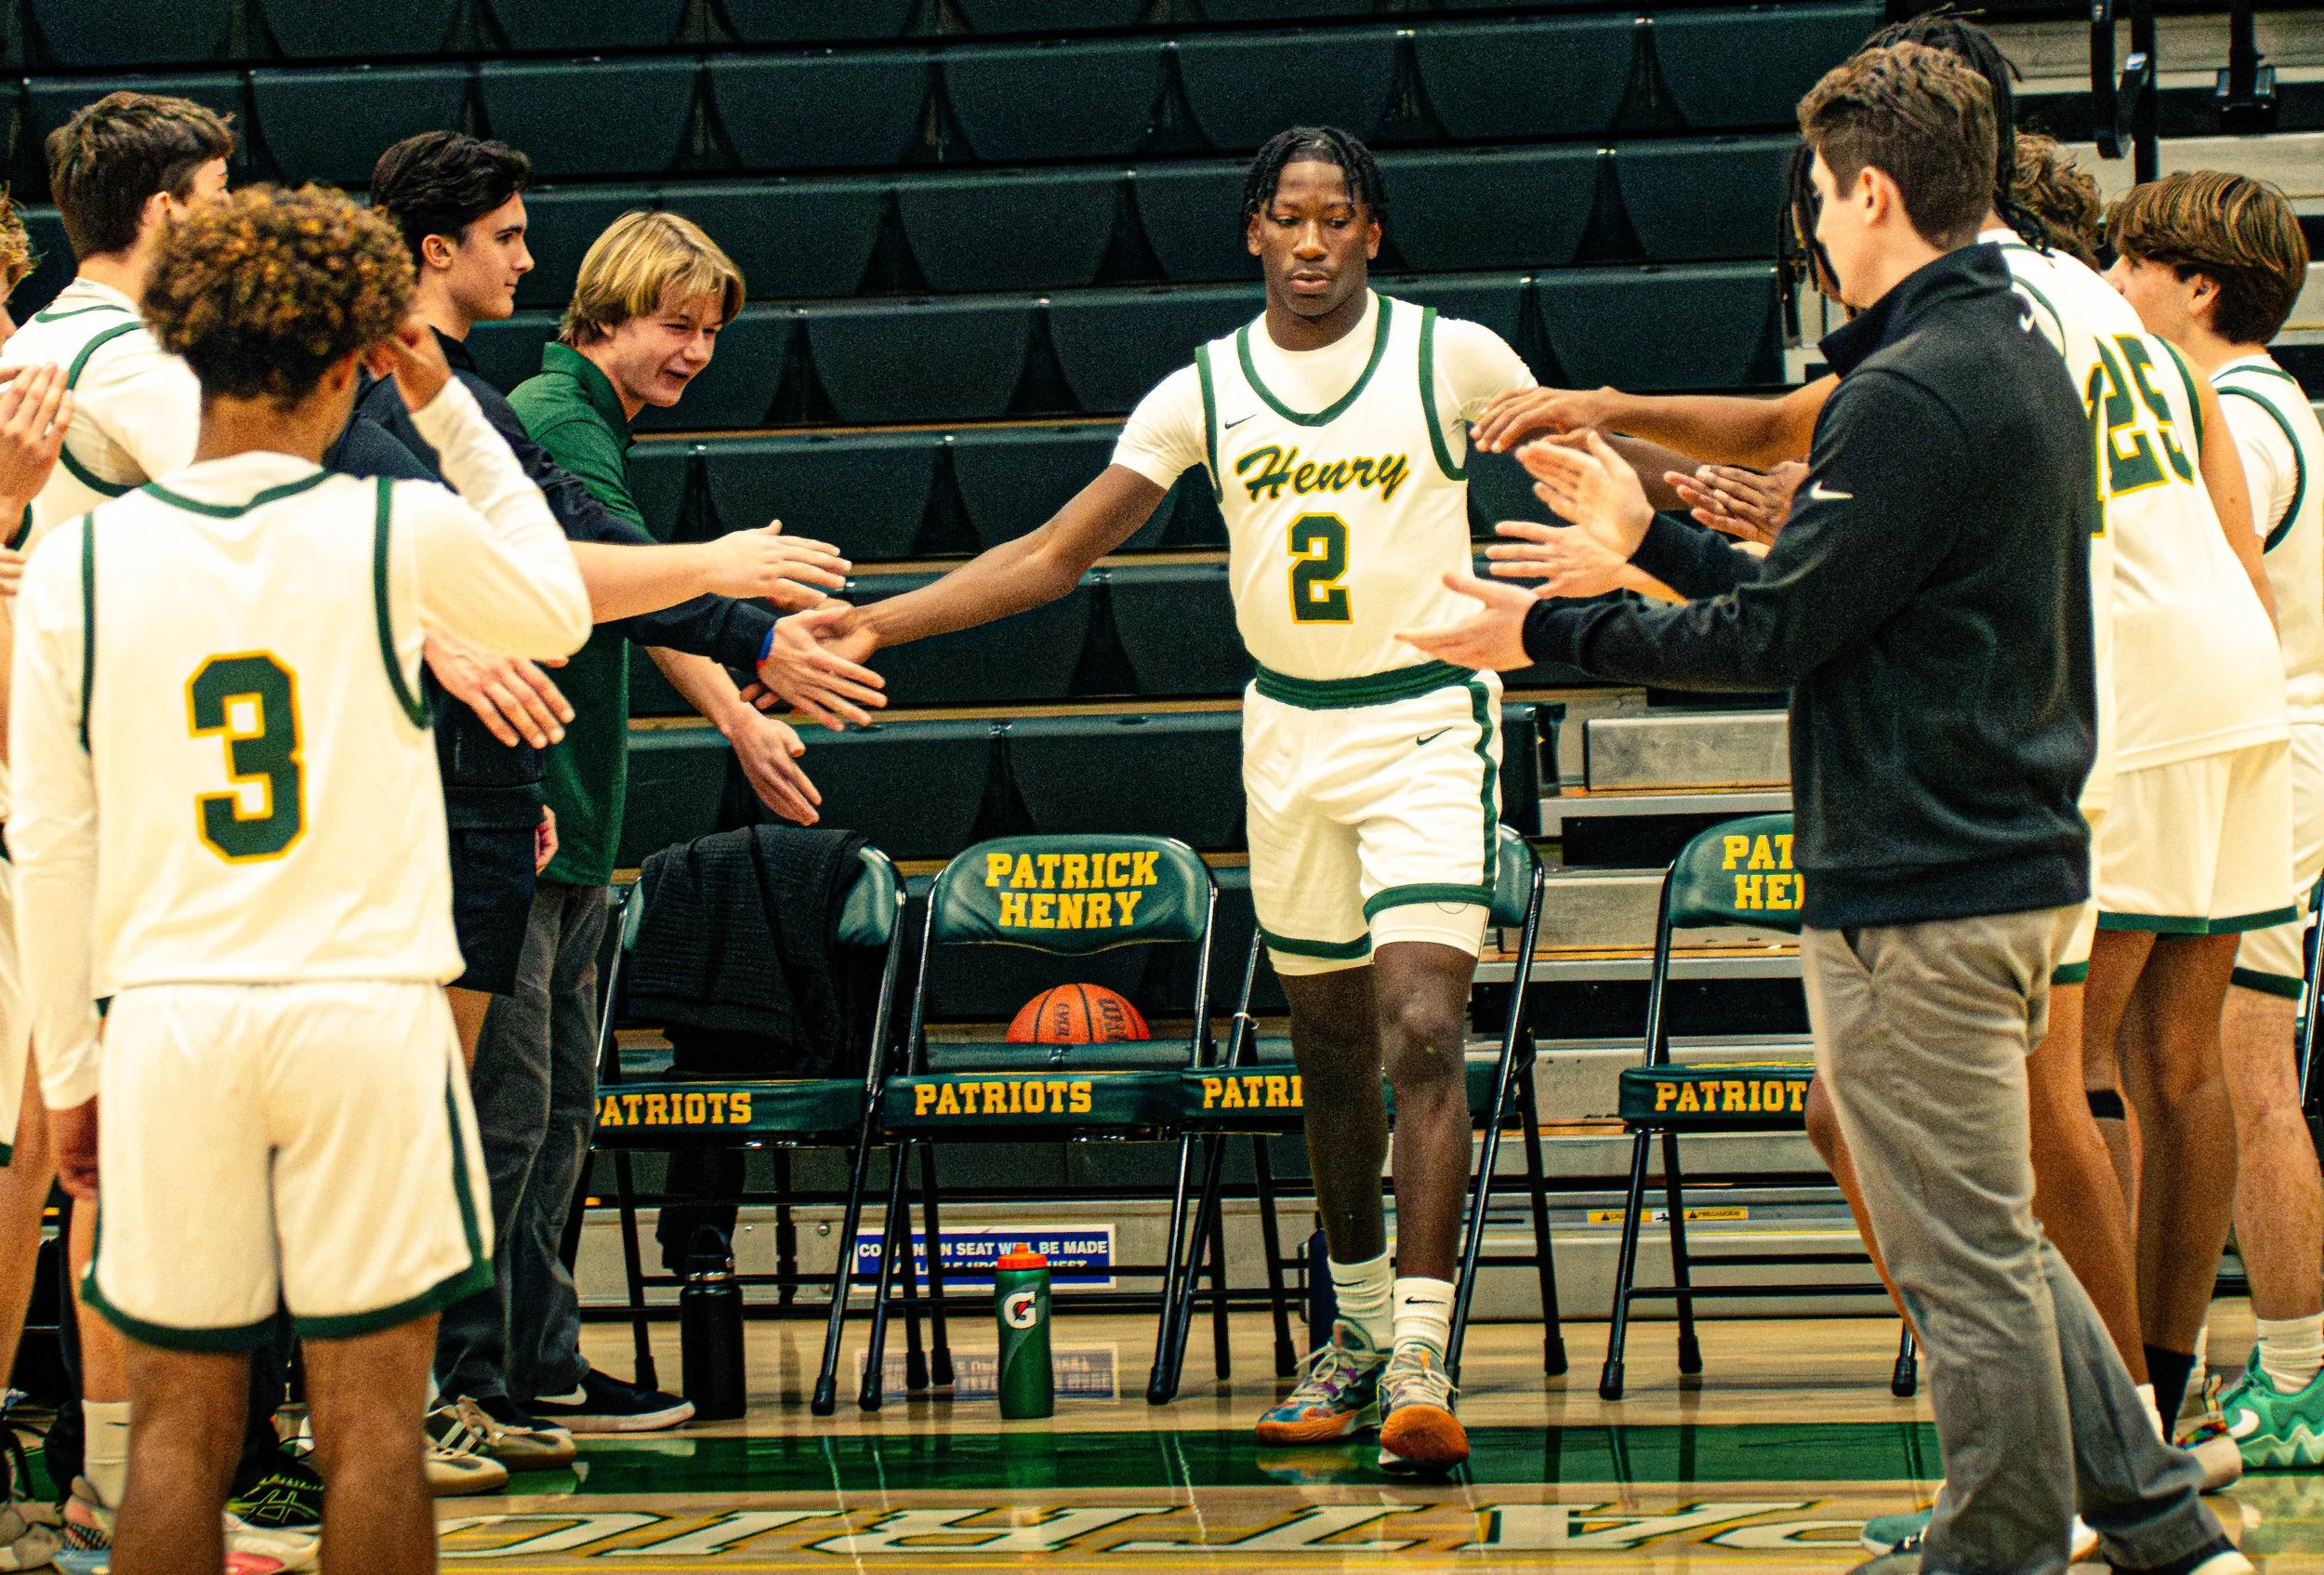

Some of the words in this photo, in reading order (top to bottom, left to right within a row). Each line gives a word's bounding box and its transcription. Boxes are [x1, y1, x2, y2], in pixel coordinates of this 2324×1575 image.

[1235, 443, 1411, 503] Henry
[1287, 511, 1354, 625] 2
[185, 648, 308, 866] 3
[984, 851, 1160, 889] PATRICK
[998, 891, 1142, 930] HENRY
[914, 1080, 1092, 1116] PATRIOTS
[956, 1242, 993, 1256] SEAT
[997, 1241, 1037, 1255] WL
[1039, 1241, 1060, 1254] BE
[1063, 1240, 1108, 1254] MADE
[1004, 1290, 1037, 1330] G
